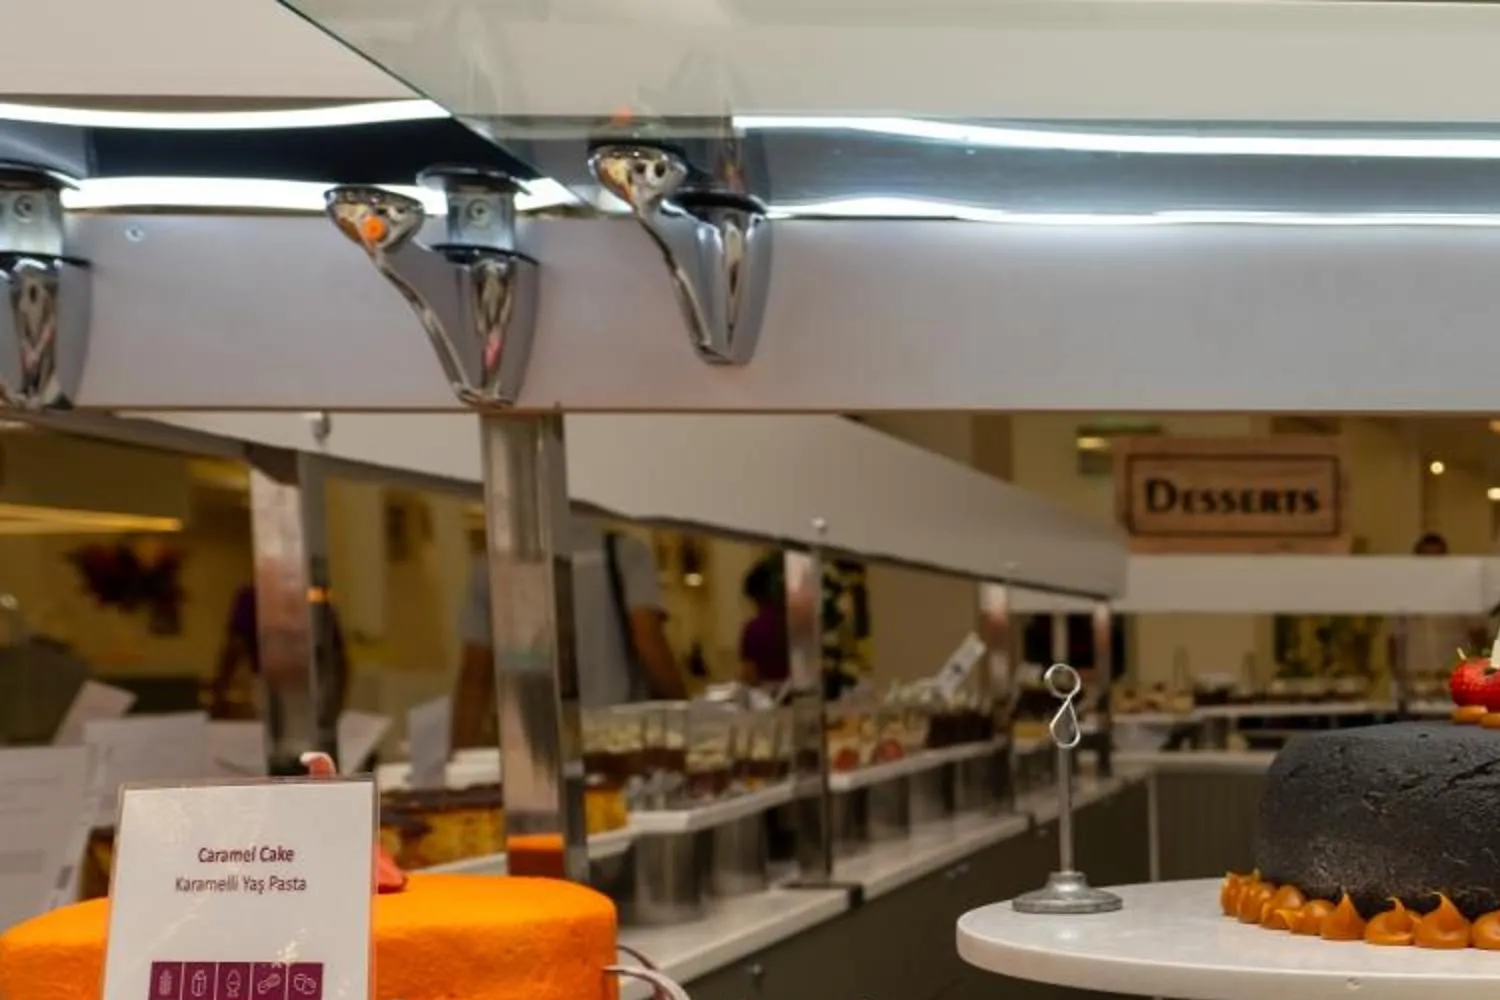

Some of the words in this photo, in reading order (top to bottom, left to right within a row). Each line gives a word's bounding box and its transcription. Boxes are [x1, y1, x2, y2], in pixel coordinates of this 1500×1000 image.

[1145, 477, 1320, 515] DESSERTS
[197, 846, 257, 863] Caramel
[259, 845, 295, 862] Cake
[175, 874, 239, 892] Karamelli
[243, 875, 265, 895] Yaş
[269, 875, 307, 892] Pasta
